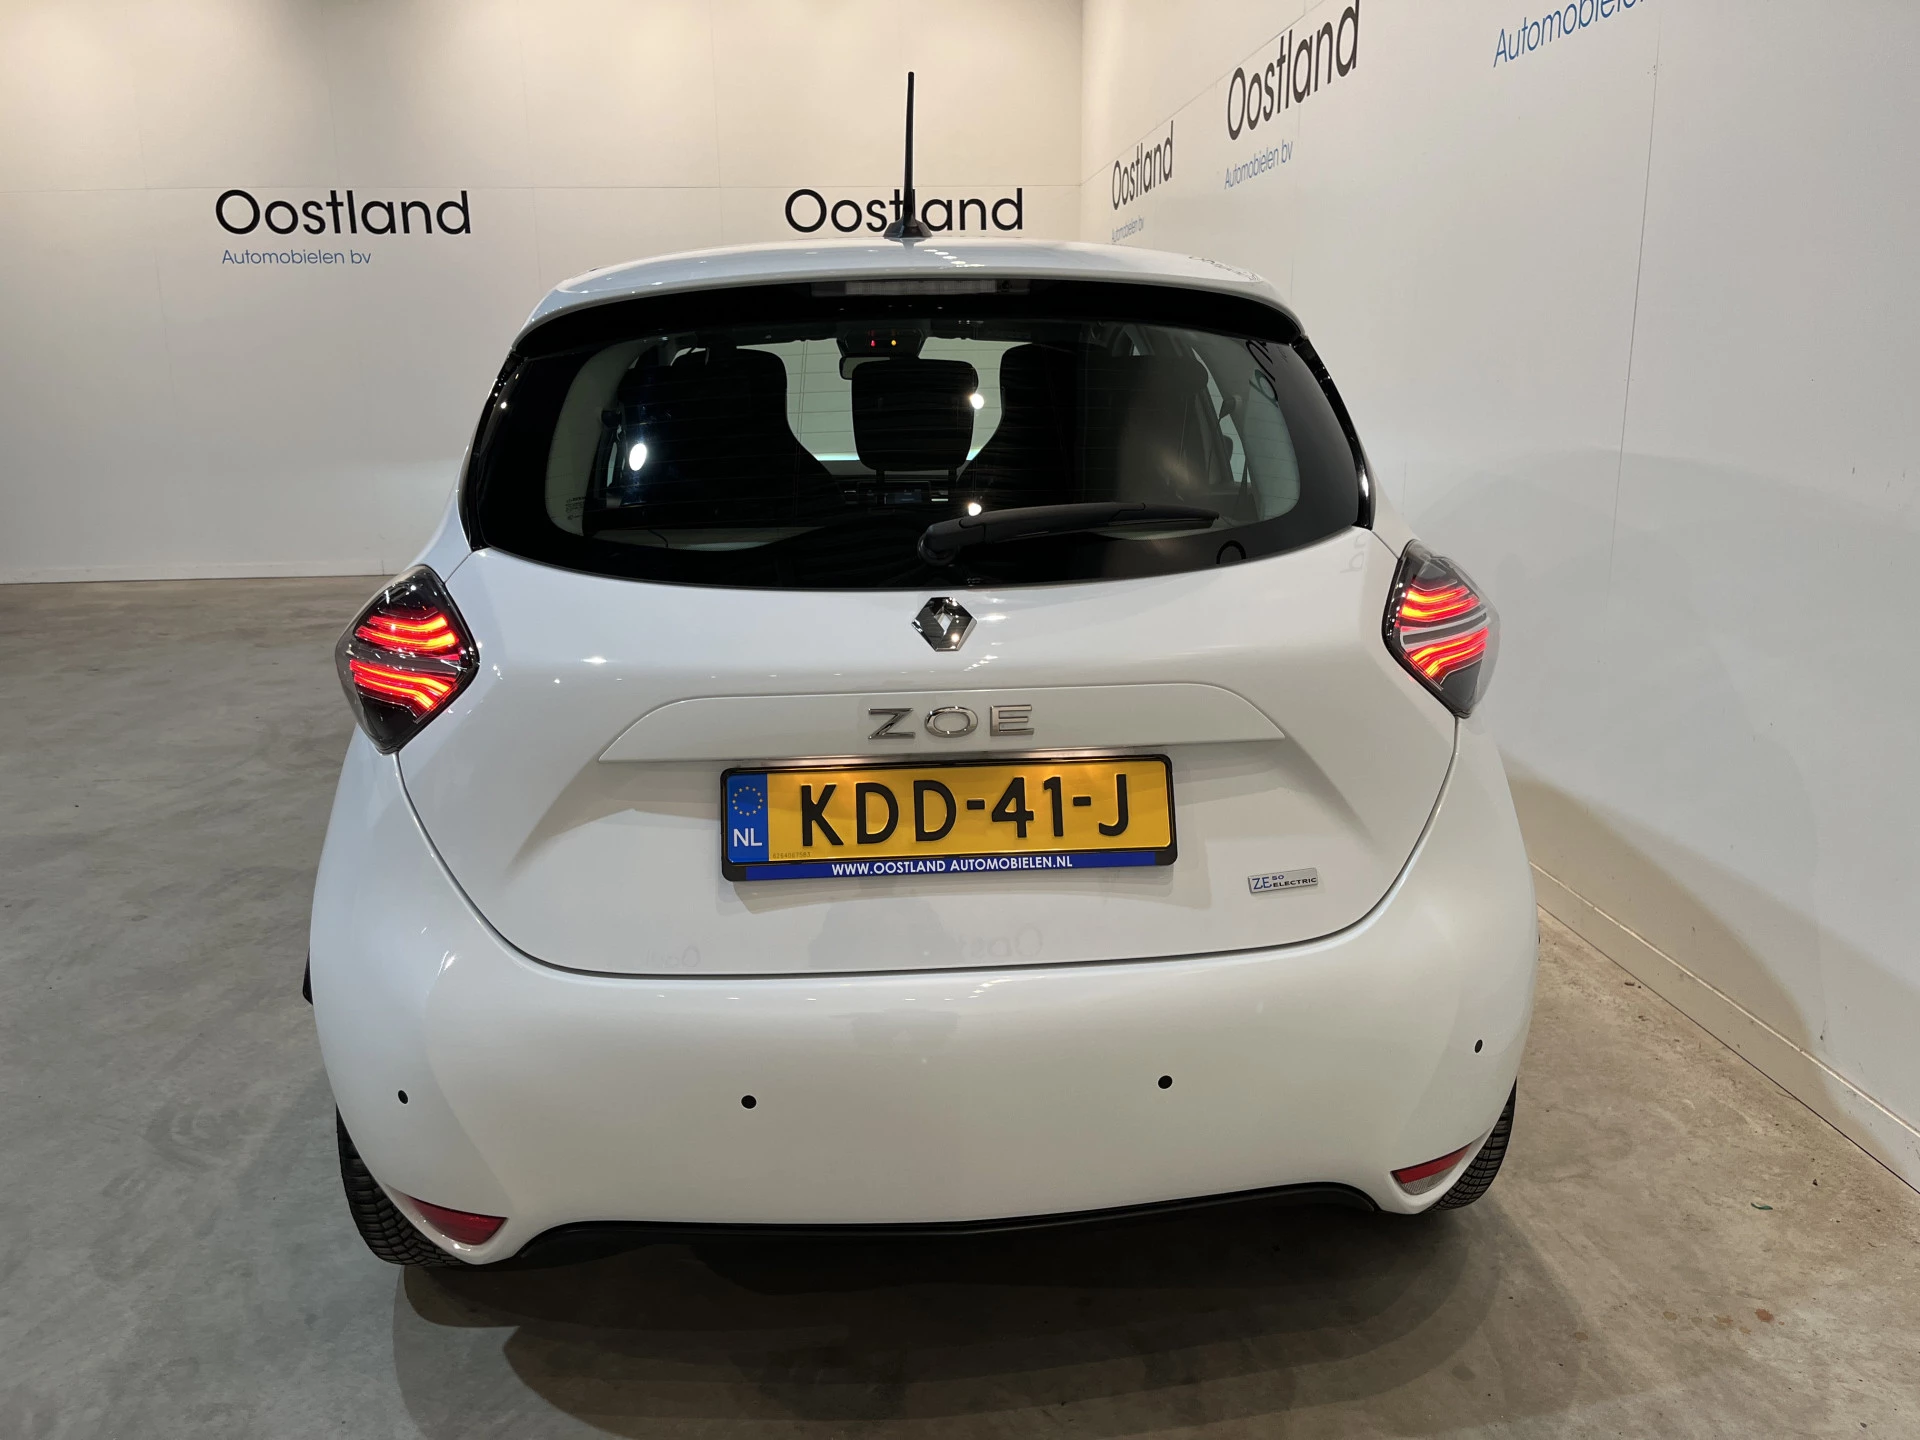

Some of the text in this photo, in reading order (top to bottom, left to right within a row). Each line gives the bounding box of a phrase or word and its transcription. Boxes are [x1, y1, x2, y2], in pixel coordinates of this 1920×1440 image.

[1227, 0, 1360, 140] Oostland
[1112, 120, 1174, 210] Oostland
[1224, 139, 1294, 189] Automobielen bv
[215, 189, 471, 235] Oostland
[222, 249, 372, 264] Automobielen bv
[868, 704, 1034, 740] ZOE
[801, 774, 1129, 847] KDD-41-J
[733, 827, 763, 847] NL
[832, 856, 1073, 876] WWW.OOSTLAND AUTOMOBIELEN.NL
[1252, 876, 1272, 890] ZE
[1273, 877, 1317, 888] ELECTRIC
